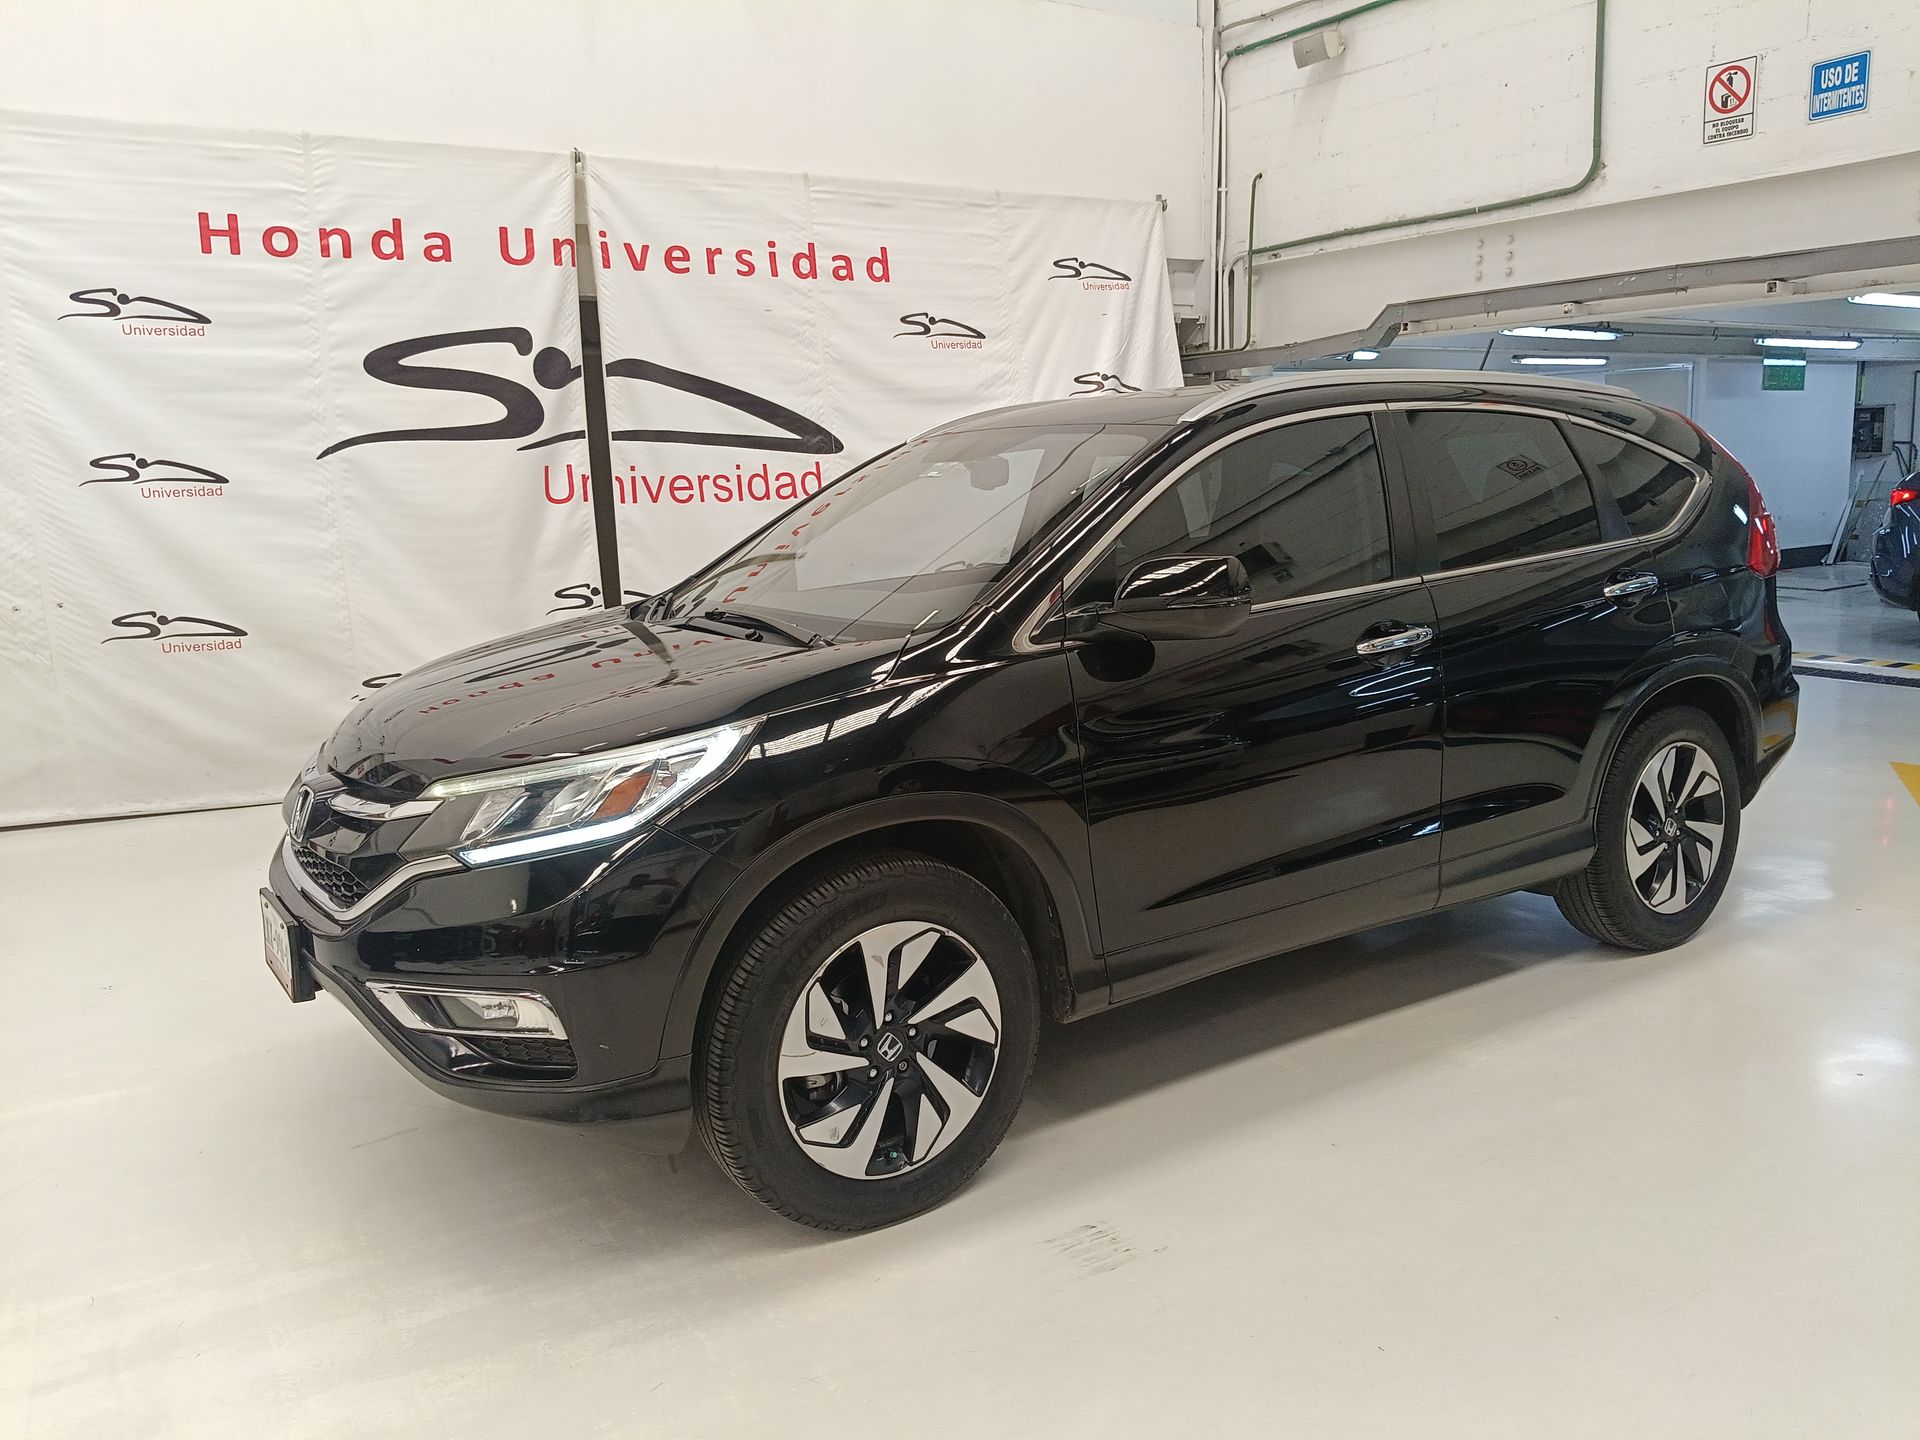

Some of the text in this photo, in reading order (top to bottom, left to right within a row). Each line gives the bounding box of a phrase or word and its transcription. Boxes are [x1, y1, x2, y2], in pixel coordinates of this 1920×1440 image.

[1821, 62, 1859, 89] USO DE
[1813, 84, 1864, 113] INTERMITENTES
[1720, 118, 1744, 127] BLOQUEAR
[1726, 128, 1749, 137] INCENDIO
[198, 212, 891, 284] Honda Universidad
[1083, 282, 1130, 291] Universidad
[121, 324, 206, 337] Universidad
[930, 339, 984, 350] Universidad
[140, 485, 224, 499] Universidad
[160, 639, 244, 655] Universidad
